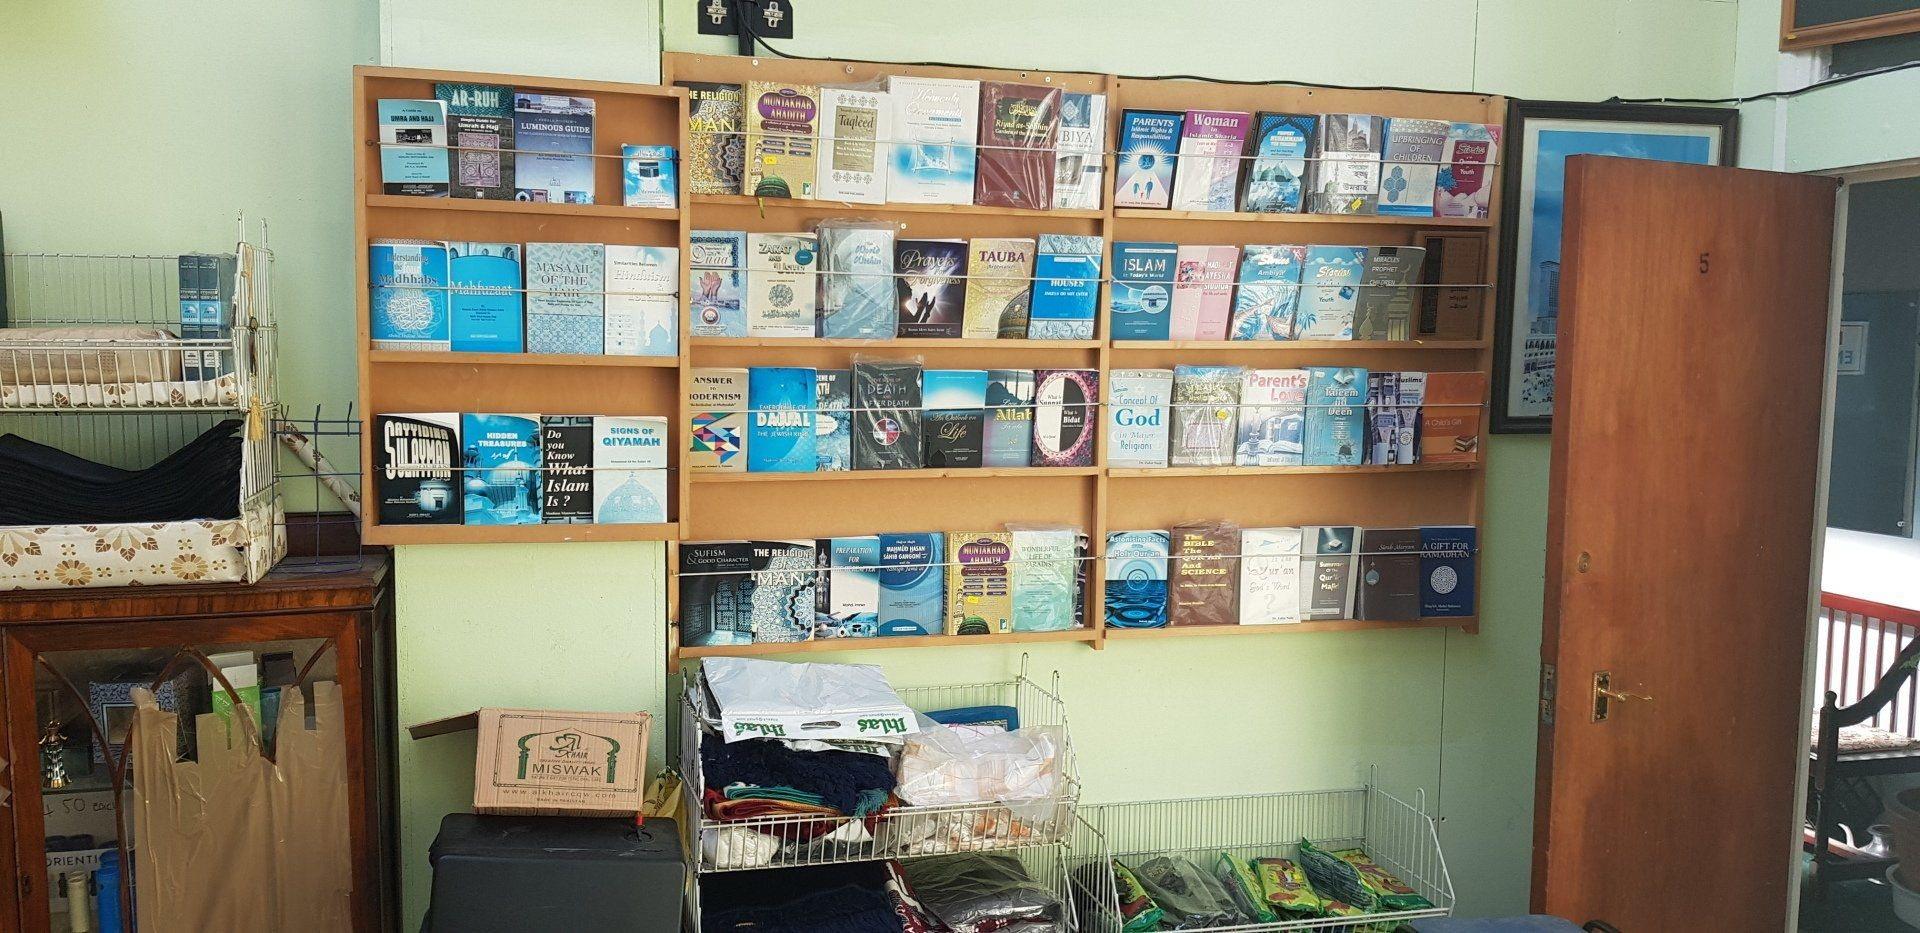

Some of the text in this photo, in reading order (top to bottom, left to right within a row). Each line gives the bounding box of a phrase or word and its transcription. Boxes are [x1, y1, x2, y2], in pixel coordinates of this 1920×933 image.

[451, 89, 500, 108] AR-RUH
[700, 91, 740, 102] RELIGION
[764, 95, 812, 109] MUNTAKHAB
[770, 109, 806, 119] AHADITH
[690, 118, 735, 132] MAN
[840, 114, 874, 129] Taqleed
[1133, 117, 1174, 127] PARENTS
[1194, 114, 1238, 127] Woman
[521, 122, 590, 133] LUMINOUS GUIDE
[1392, 135, 1443, 146] UPBRINGING
[1393, 153, 1433, 162] CHILDREN
[759, 243, 791, 255] ZAKAT
[901, 249, 955, 270] Prayers
[979, 250, 1025, 262] TAUBA
[1124, 258, 1166, 272] ISLAM
[1700, 252, 1709, 274] 5
[380, 274, 437, 285] Madhhabs
[541, 275, 588, 286] OF THE
[1051, 280, 1084, 288] HOUSES
[693, 376, 733, 385] ANSWER
[1250, 373, 1307, 388] Parent's
[868, 384, 907, 395] DEATH
[1119, 395, 1147, 405] Concept
[1271, 388, 1304, 403] Love
[1115, 408, 1160, 426] God
[547, 430, 562, 439] Do
[939, 421, 967, 441] Life
[478, 441, 527, 449] TREASURES
[547, 442, 564, 451] you
[603, 437, 661, 447] QIYAMAH
[1120, 441, 1152, 451] Religions
[547, 451, 575, 460] Know
[548, 462, 588, 475] What
[547, 479, 589, 493] Islam
[547, 496, 571, 507] Is ?
[1431, 542, 1451, 550] GIFT
[1452, 542, 1469, 550] FOR
[695, 550, 726, 558] SUFISM
[754, 549, 808, 558] THE RELIGION
[1181, 568, 1227, 576] SCIENCE
[757, 572, 806, 586] MAN
[532, 763, 602, 776] MISWAK
[62, 797, 86, 813] 50
